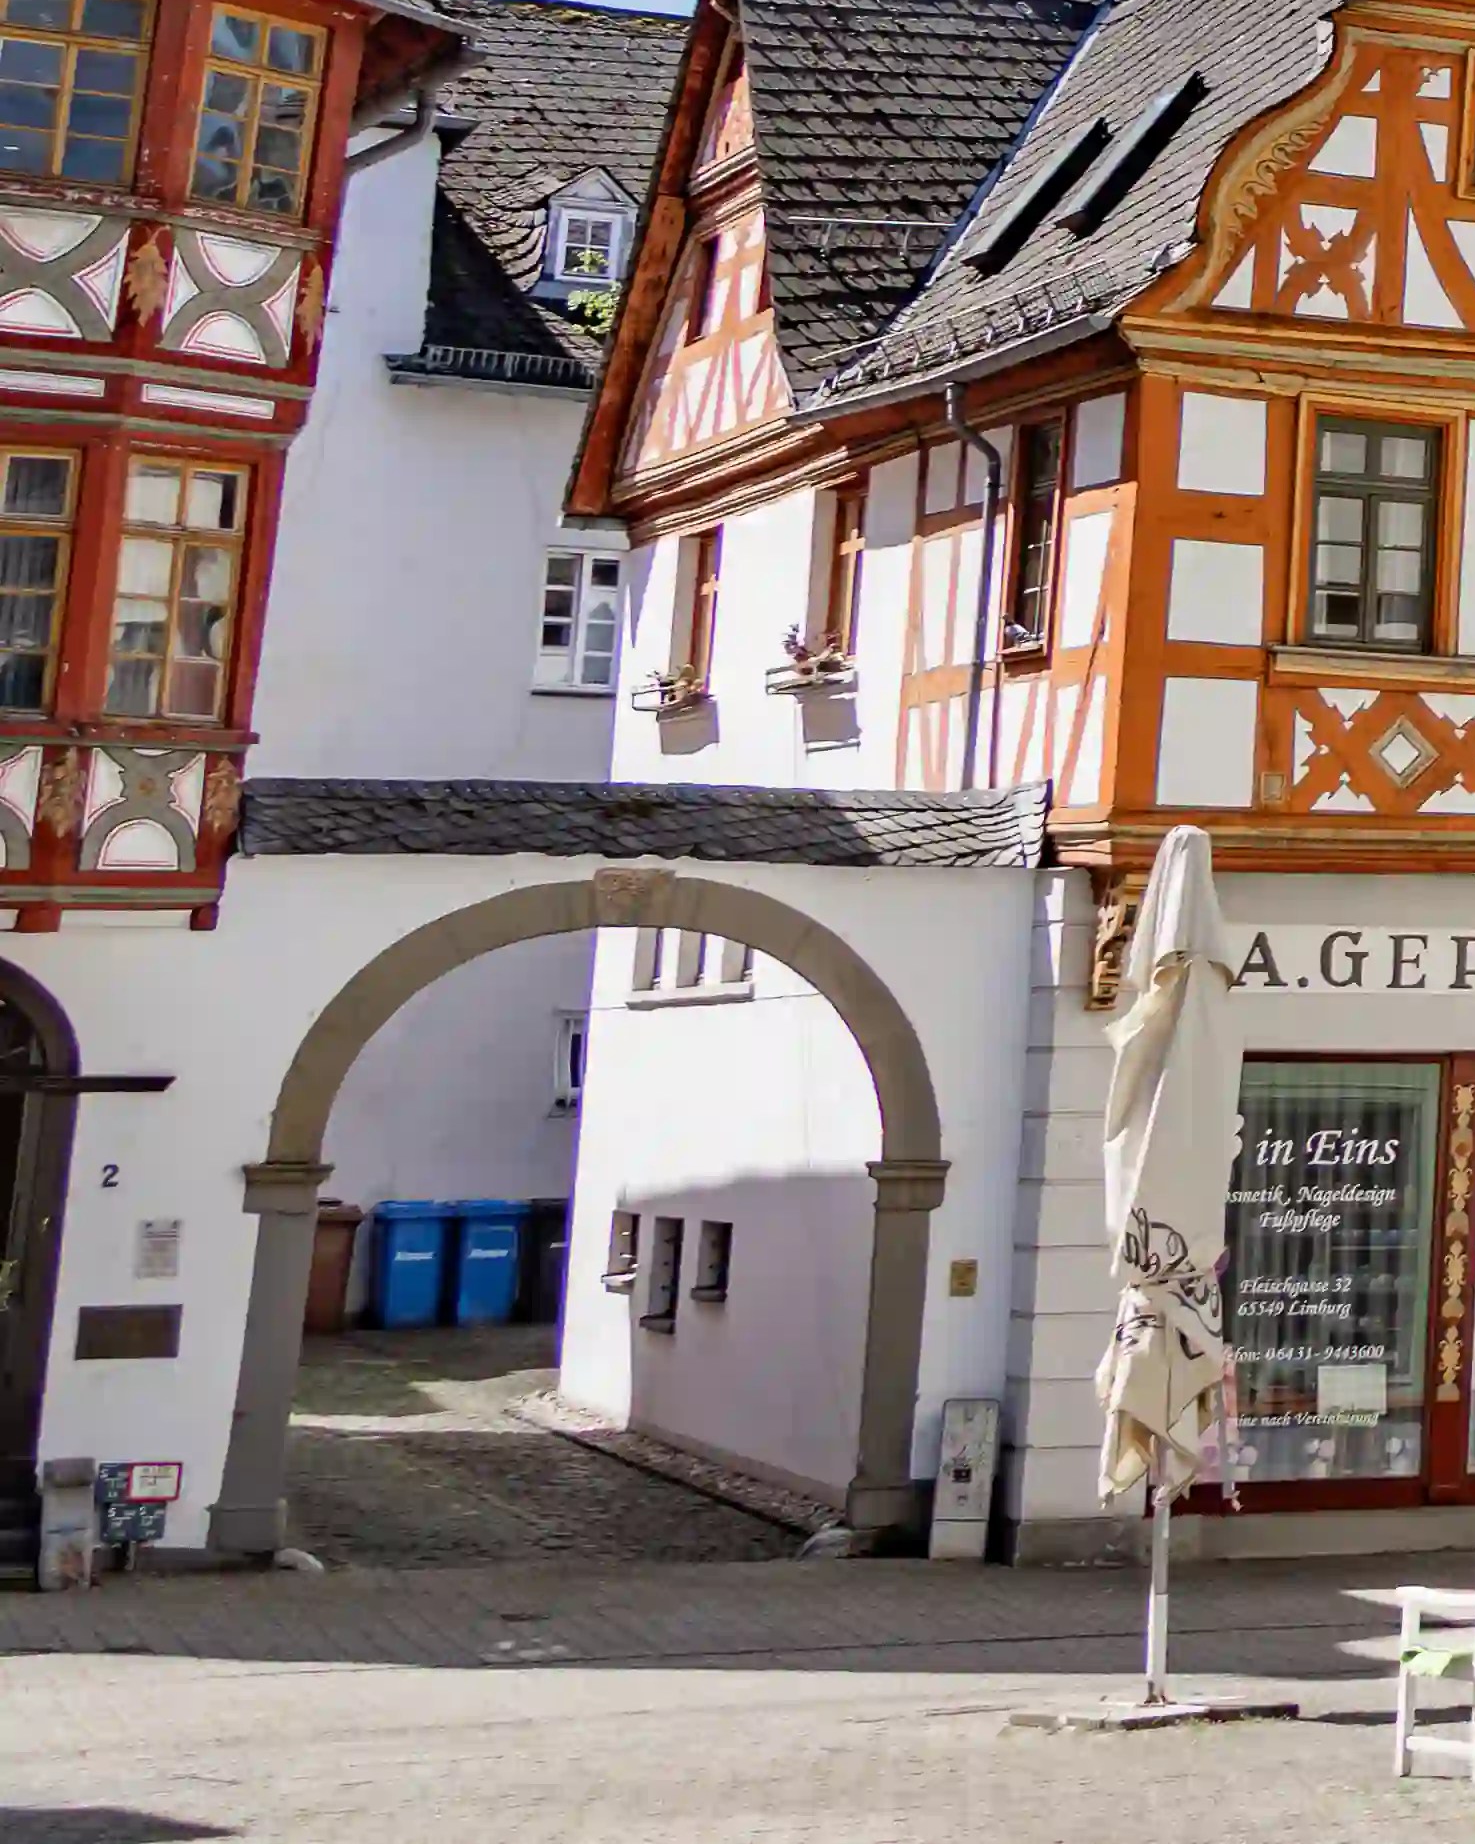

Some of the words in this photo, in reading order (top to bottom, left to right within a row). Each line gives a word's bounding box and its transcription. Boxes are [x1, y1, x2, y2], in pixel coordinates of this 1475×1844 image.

[1256, 1128, 1296, 1166] in
[1305, 1127, 1400, 1166] Eins
[102, 1164, 119, 1188] 2
[1296, 1183, 1397, 1207] Nageldesign
[1259, 1208, 1341, 1233] Fußpflege
[1239, 1276, 1329, 1298] Fleischgasse
[1331, 1277, 1352, 1293] 32
[1237, 1301, 1285, 1317] 65549
[1287, 1300, 1352, 1320] Limburg
[1261, 1411, 1291, 1426] nach
